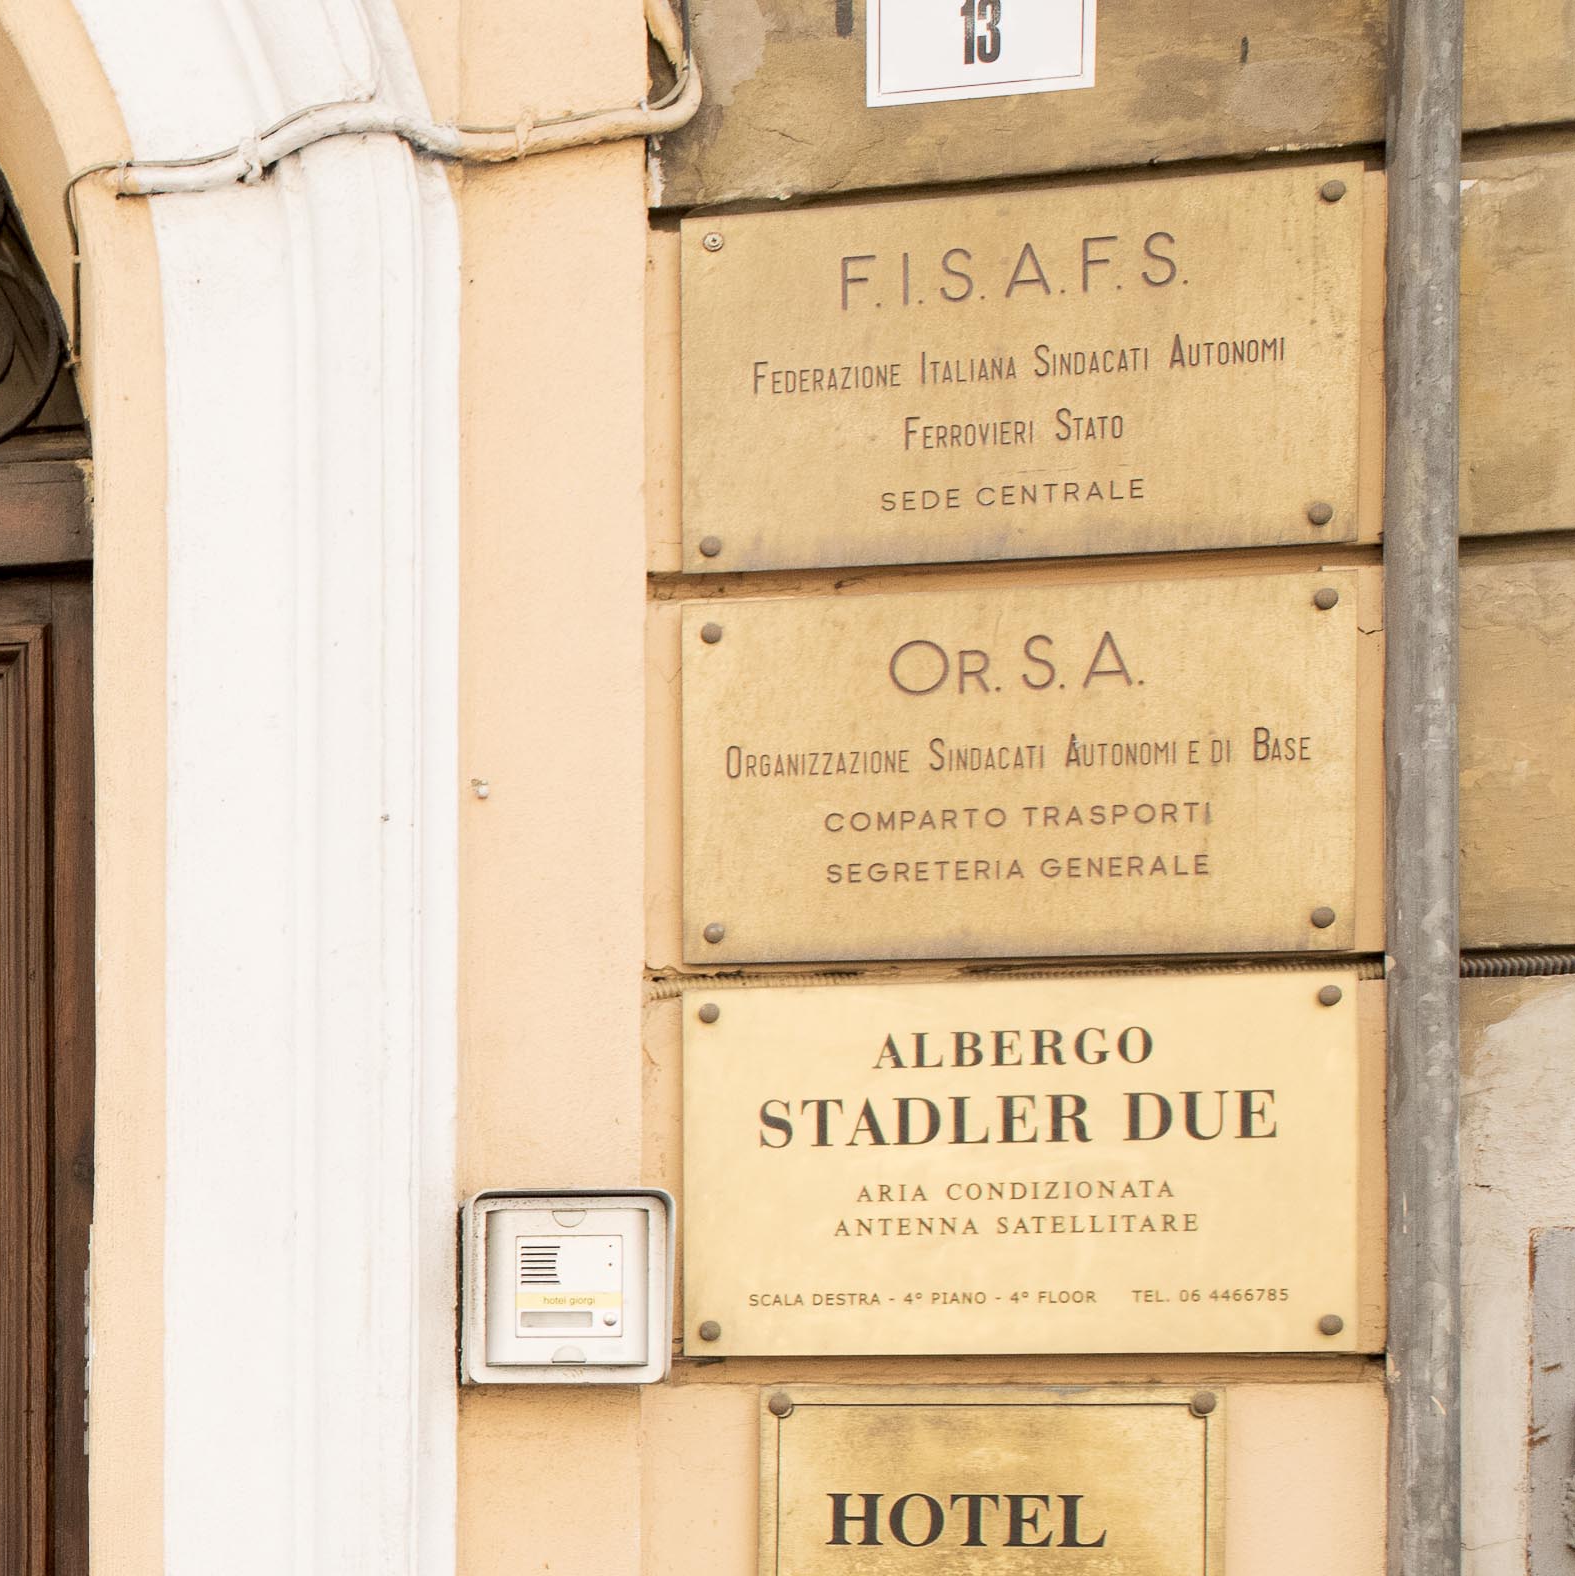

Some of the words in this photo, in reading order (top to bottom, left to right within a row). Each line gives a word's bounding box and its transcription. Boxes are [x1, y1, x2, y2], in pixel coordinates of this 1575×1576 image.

[960, 0, 1001, 65] 13
[880, 487, 961, 512] SEDE
[975, 478, 1145, 507] CENTRALE
[1187, 738, 1201, 765] E
[1210, 738, 1231, 766] DI
[824, 807, 1008, 833] COMPARTO
[1022, 801, 1213, 828] TRASPORTI
[825, 858, 1026, 884] SEGRETERIA
[1039, 854, 1211, 880] GENERALE
[872, 1026, 1154, 1069] ALBERGO
[758, 1093, 1093, 1148] STADLER
[1122, 1089, 1278, 1142] DUE
[856, 1183, 929, 1204] ARIA
[946, 1179, 1175, 1202] CONDIZIONATA
[834, 1216, 980, 1237] ANTENNA
[996, 1213, 1199, 1236] SATELLITARE
[542, 1295, 567, 1306] hotel
[569, 1296, 596, 1306] giorgi
[749, 1293, 804, 1307] SCALA
[812, 1292, 881, 1306] DESTRA
[931, 1291, 987, 1305] PIANO
[1038, 1290, 1098, 1304] FLOOR
[1132, 1289, 1171, 1303] TEL.
[1179, 1288, 1201, 1302] 06
[1209, 1288, 1289, 1302] 4466785
[825, 1492, 1107, 1548] HOTEL
